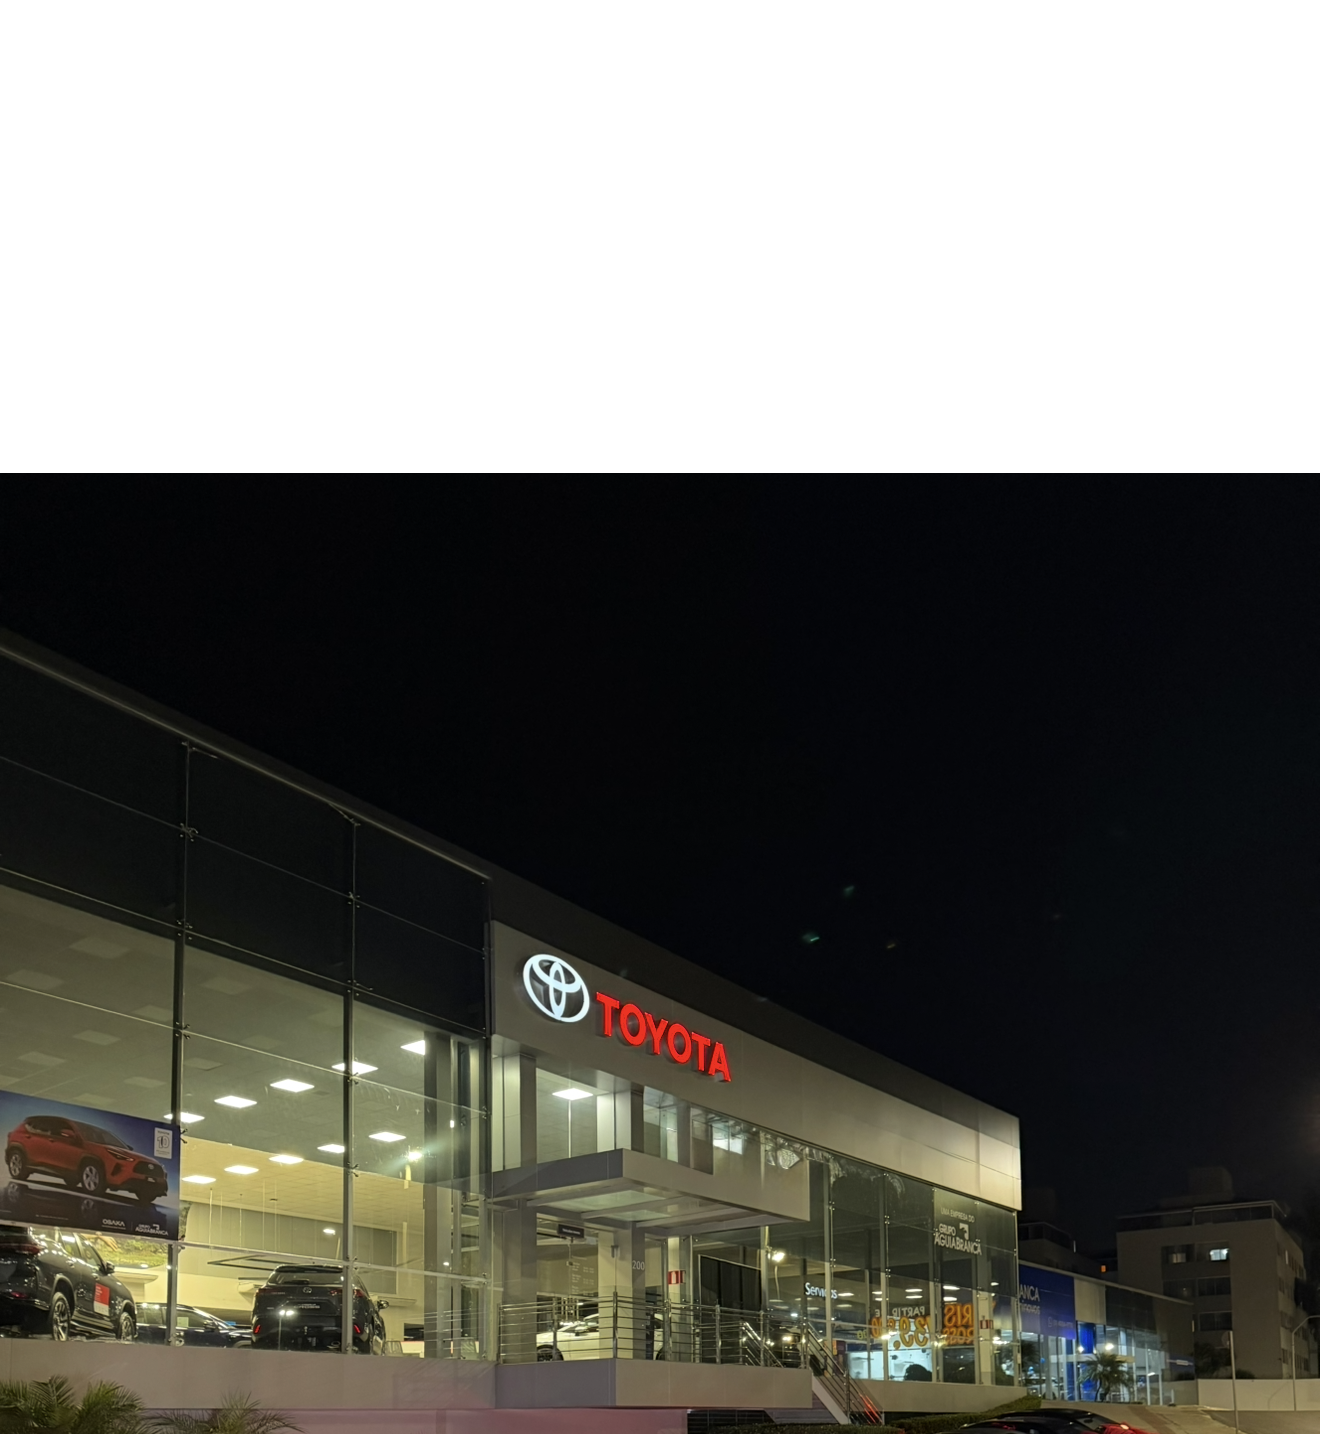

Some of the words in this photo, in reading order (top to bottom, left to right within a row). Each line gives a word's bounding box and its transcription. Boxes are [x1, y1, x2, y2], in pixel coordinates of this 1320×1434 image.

[596, 991, 731, 1082] TOYOTA
[941, 1206, 950, 1216] UMA
[950, 1209, 968, 1221] EMPRESA
[968, 1214, 975, 1223] DO
[939, 1223, 956, 1237] GRUPO
[632, 1260, 645, 1271] 200
[805, 1282, 838, 1300] Servis
[1020, 1284, 1040, 1302] ANCA
